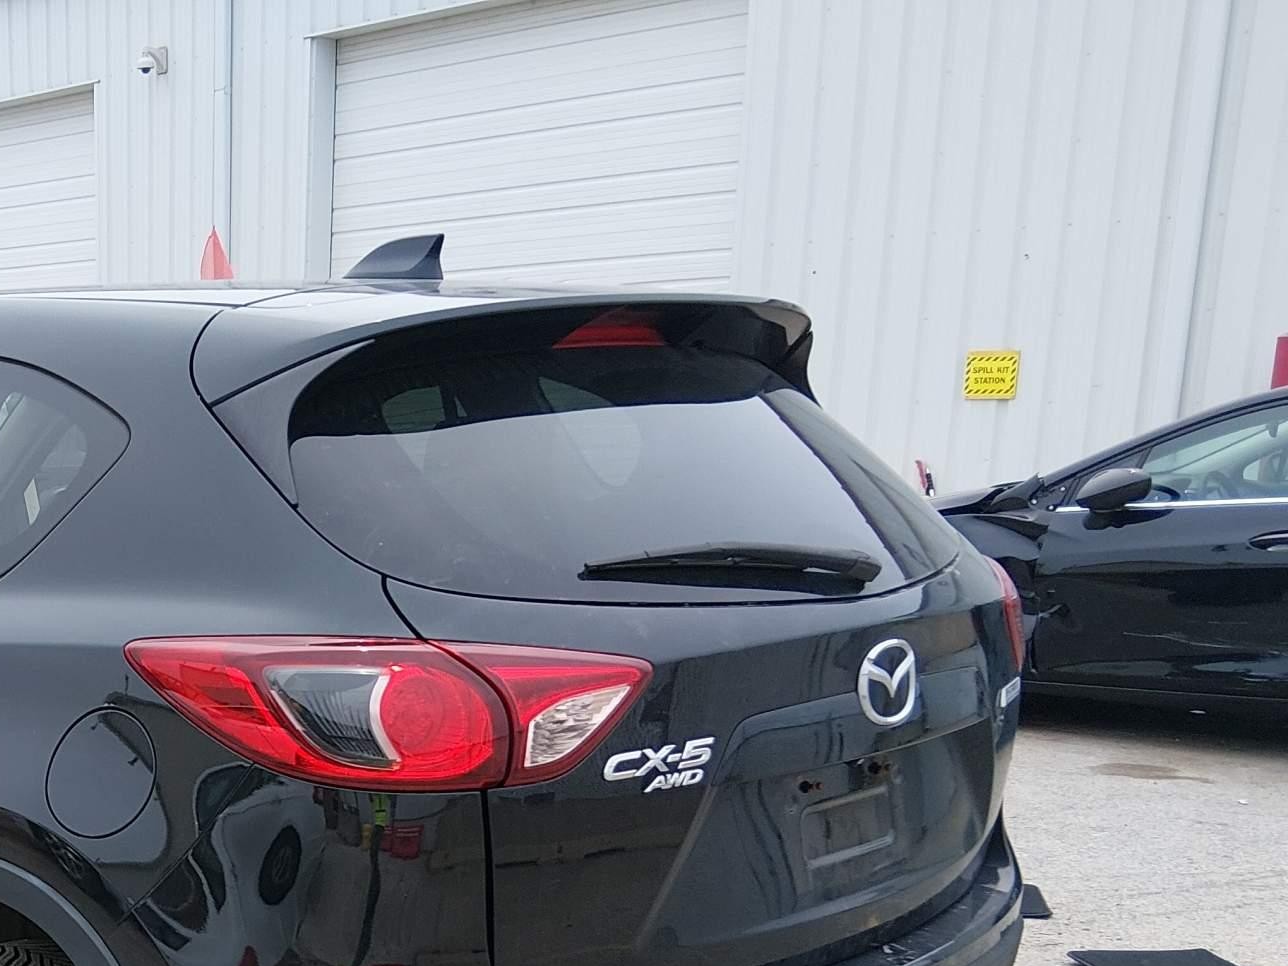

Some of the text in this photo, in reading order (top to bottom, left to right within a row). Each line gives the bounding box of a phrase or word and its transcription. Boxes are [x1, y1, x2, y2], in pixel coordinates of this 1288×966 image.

[972, 366, 1010, 374] SPILL KIT
[973, 377, 1006, 385] STATION
[603, 737, 716, 782] CX-5
[643, 768, 705, 793] AWD
